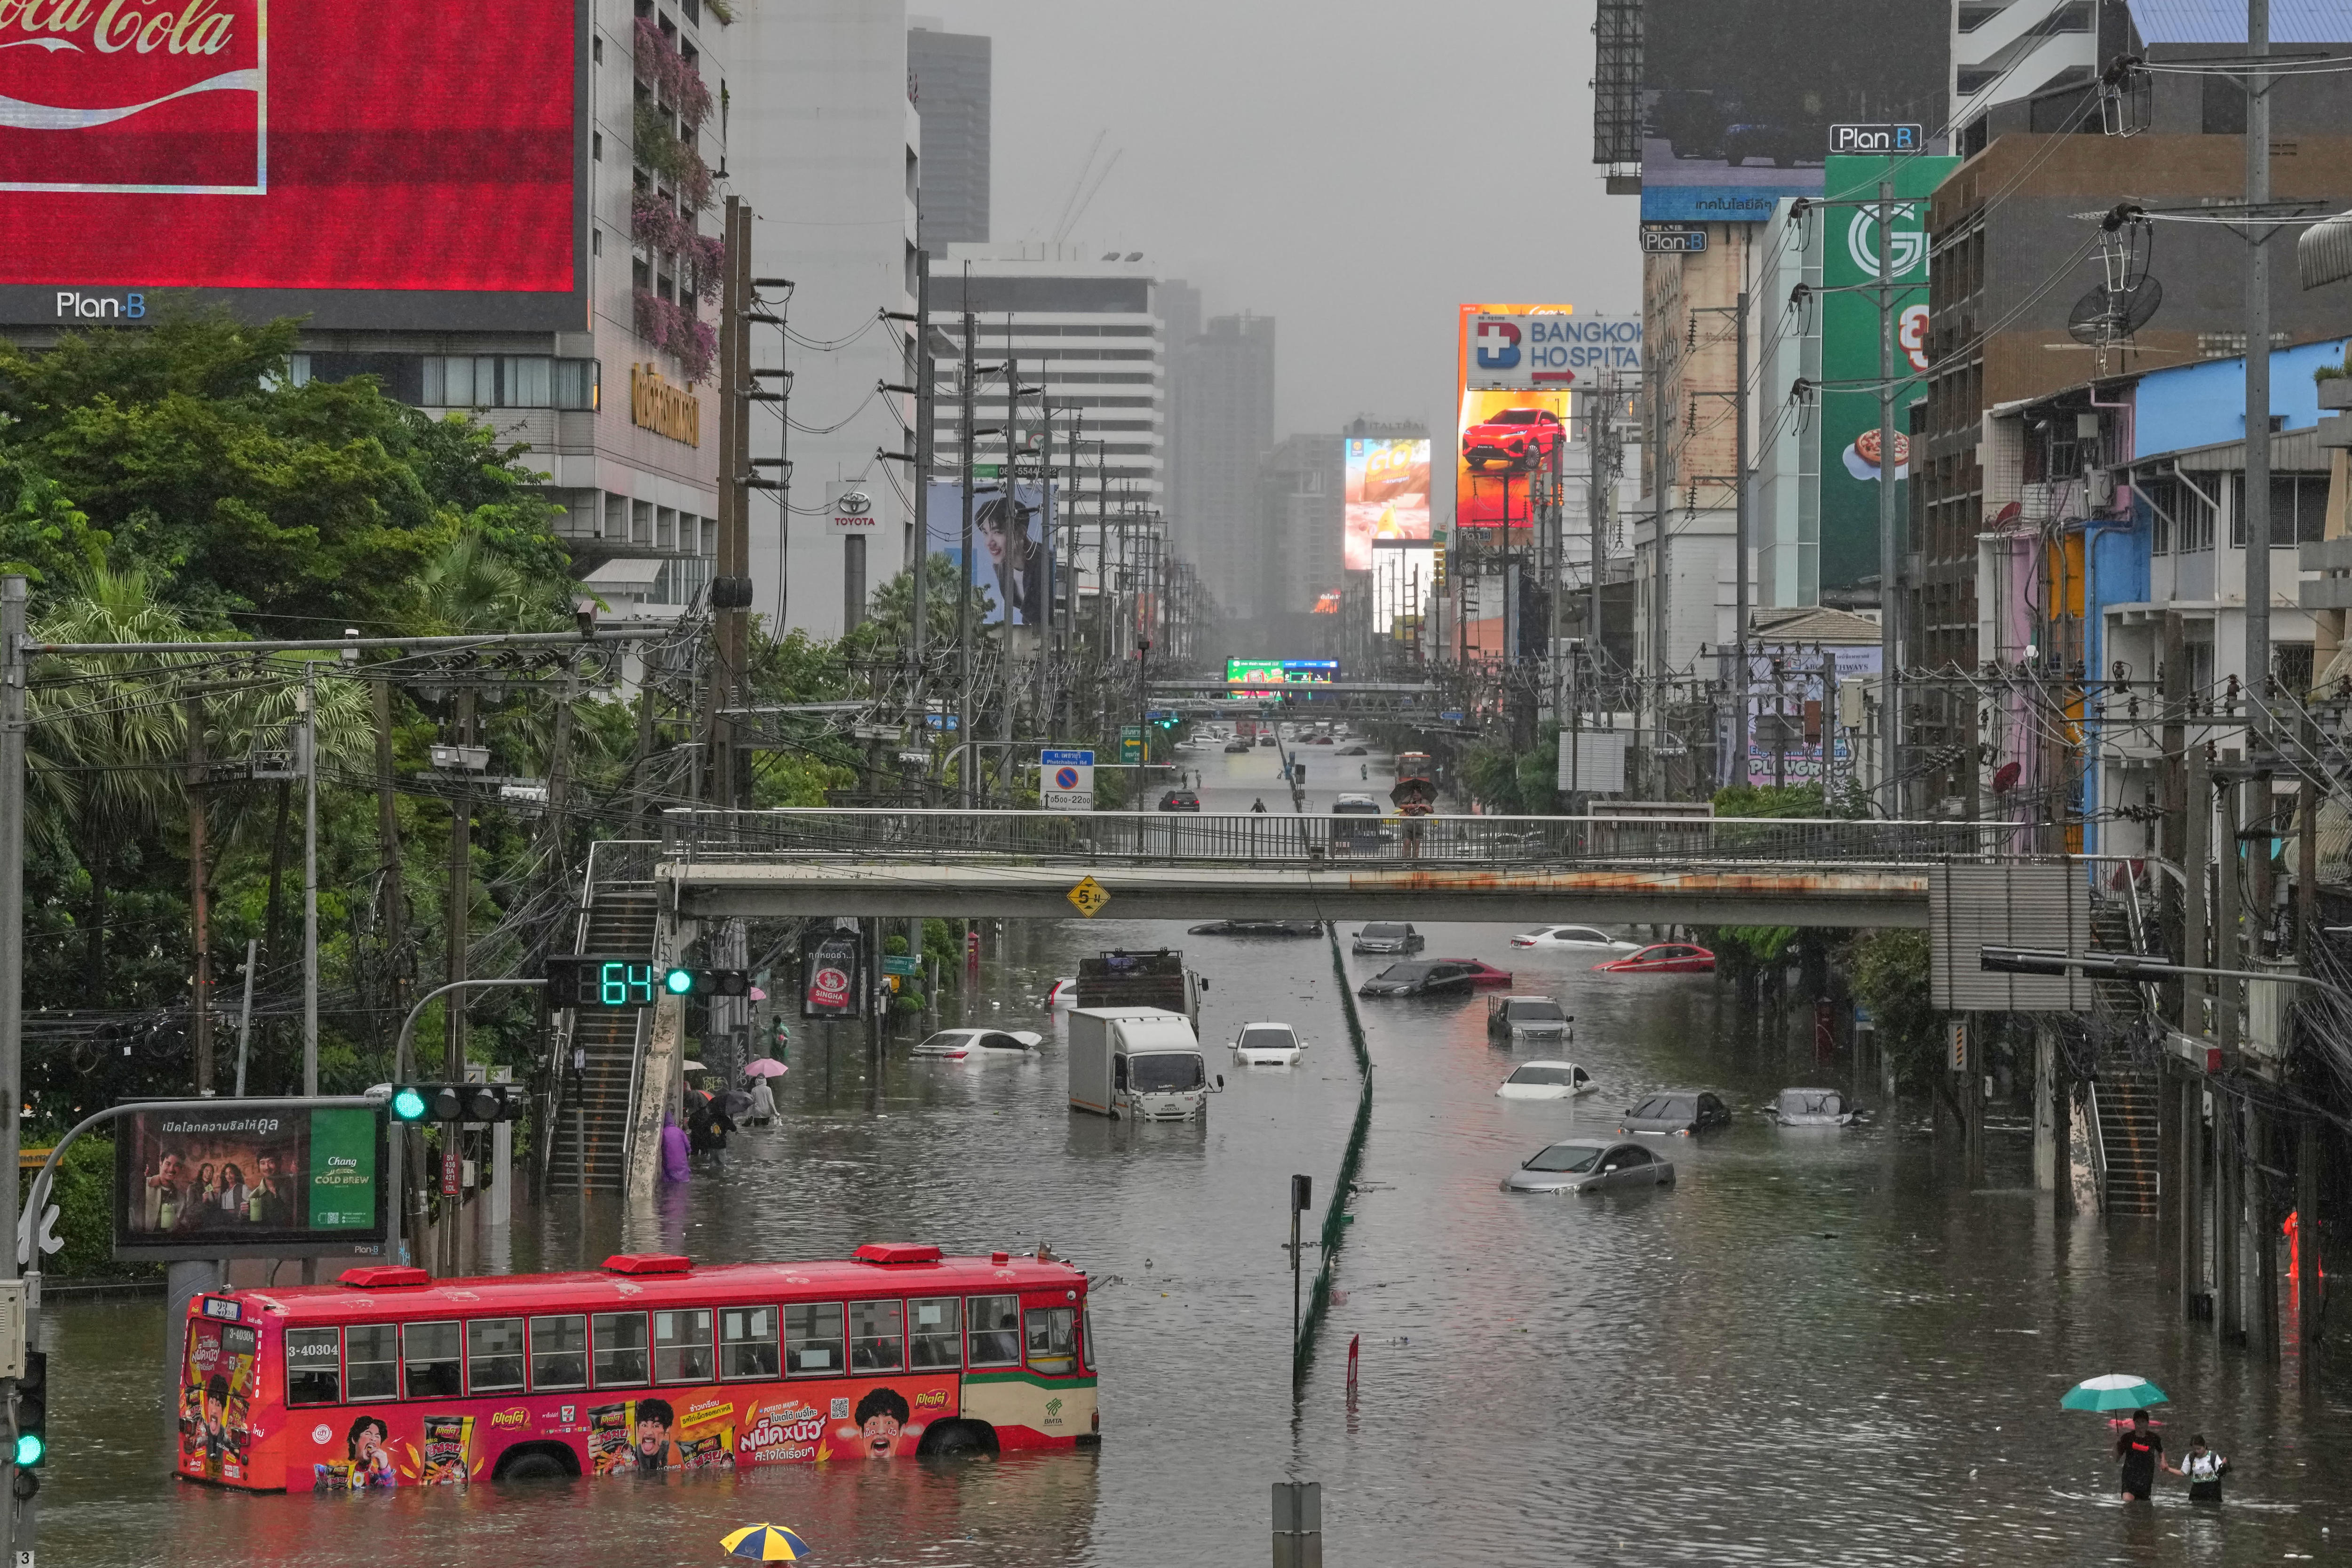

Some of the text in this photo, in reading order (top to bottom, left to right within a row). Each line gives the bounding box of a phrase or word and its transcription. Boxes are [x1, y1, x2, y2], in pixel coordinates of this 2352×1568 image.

[1840, 128, 1889, 148] Plan
[1695, 198, 1772, 212] เทคโนโลยีดีๆ
[1647, 234, 1685, 249] Plan
[57, 292, 119, 318] Plan
[1531, 347, 1640, 367] HOSPITA
[1366, 444, 1412, 476] GO
[834, 517, 875, 525] TOYOTA
[1079, 890, 1089, 904] 5
[603, 963, 651, 1004] 64
[815, 989, 843, 1001] SINGHA
[328, 1157, 357, 1167] Chang
[229, 1328, 254, 1342] 3-40304
[288, 1344, 338, 1357] 3-40304
[690, 1400, 720, 1412] ข้าวเกรียบ
[763, 1400, 799, 1413] POTATO MAJIKO
[682, 1404, 731, 1424] รสไก่เผ็ดซอสเกาหลี
[253, 1423, 265, 1437] ใหม่
[864, 1427, 876, 1438] เผ็ด
[888, 1427, 897, 1436] นัว
[426, 1441, 463, 1457] 양념치킨
[755, 1444, 815, 1462] สะใจได้เรื่อยๆ
[21, 1552, 29, 1564] 3
